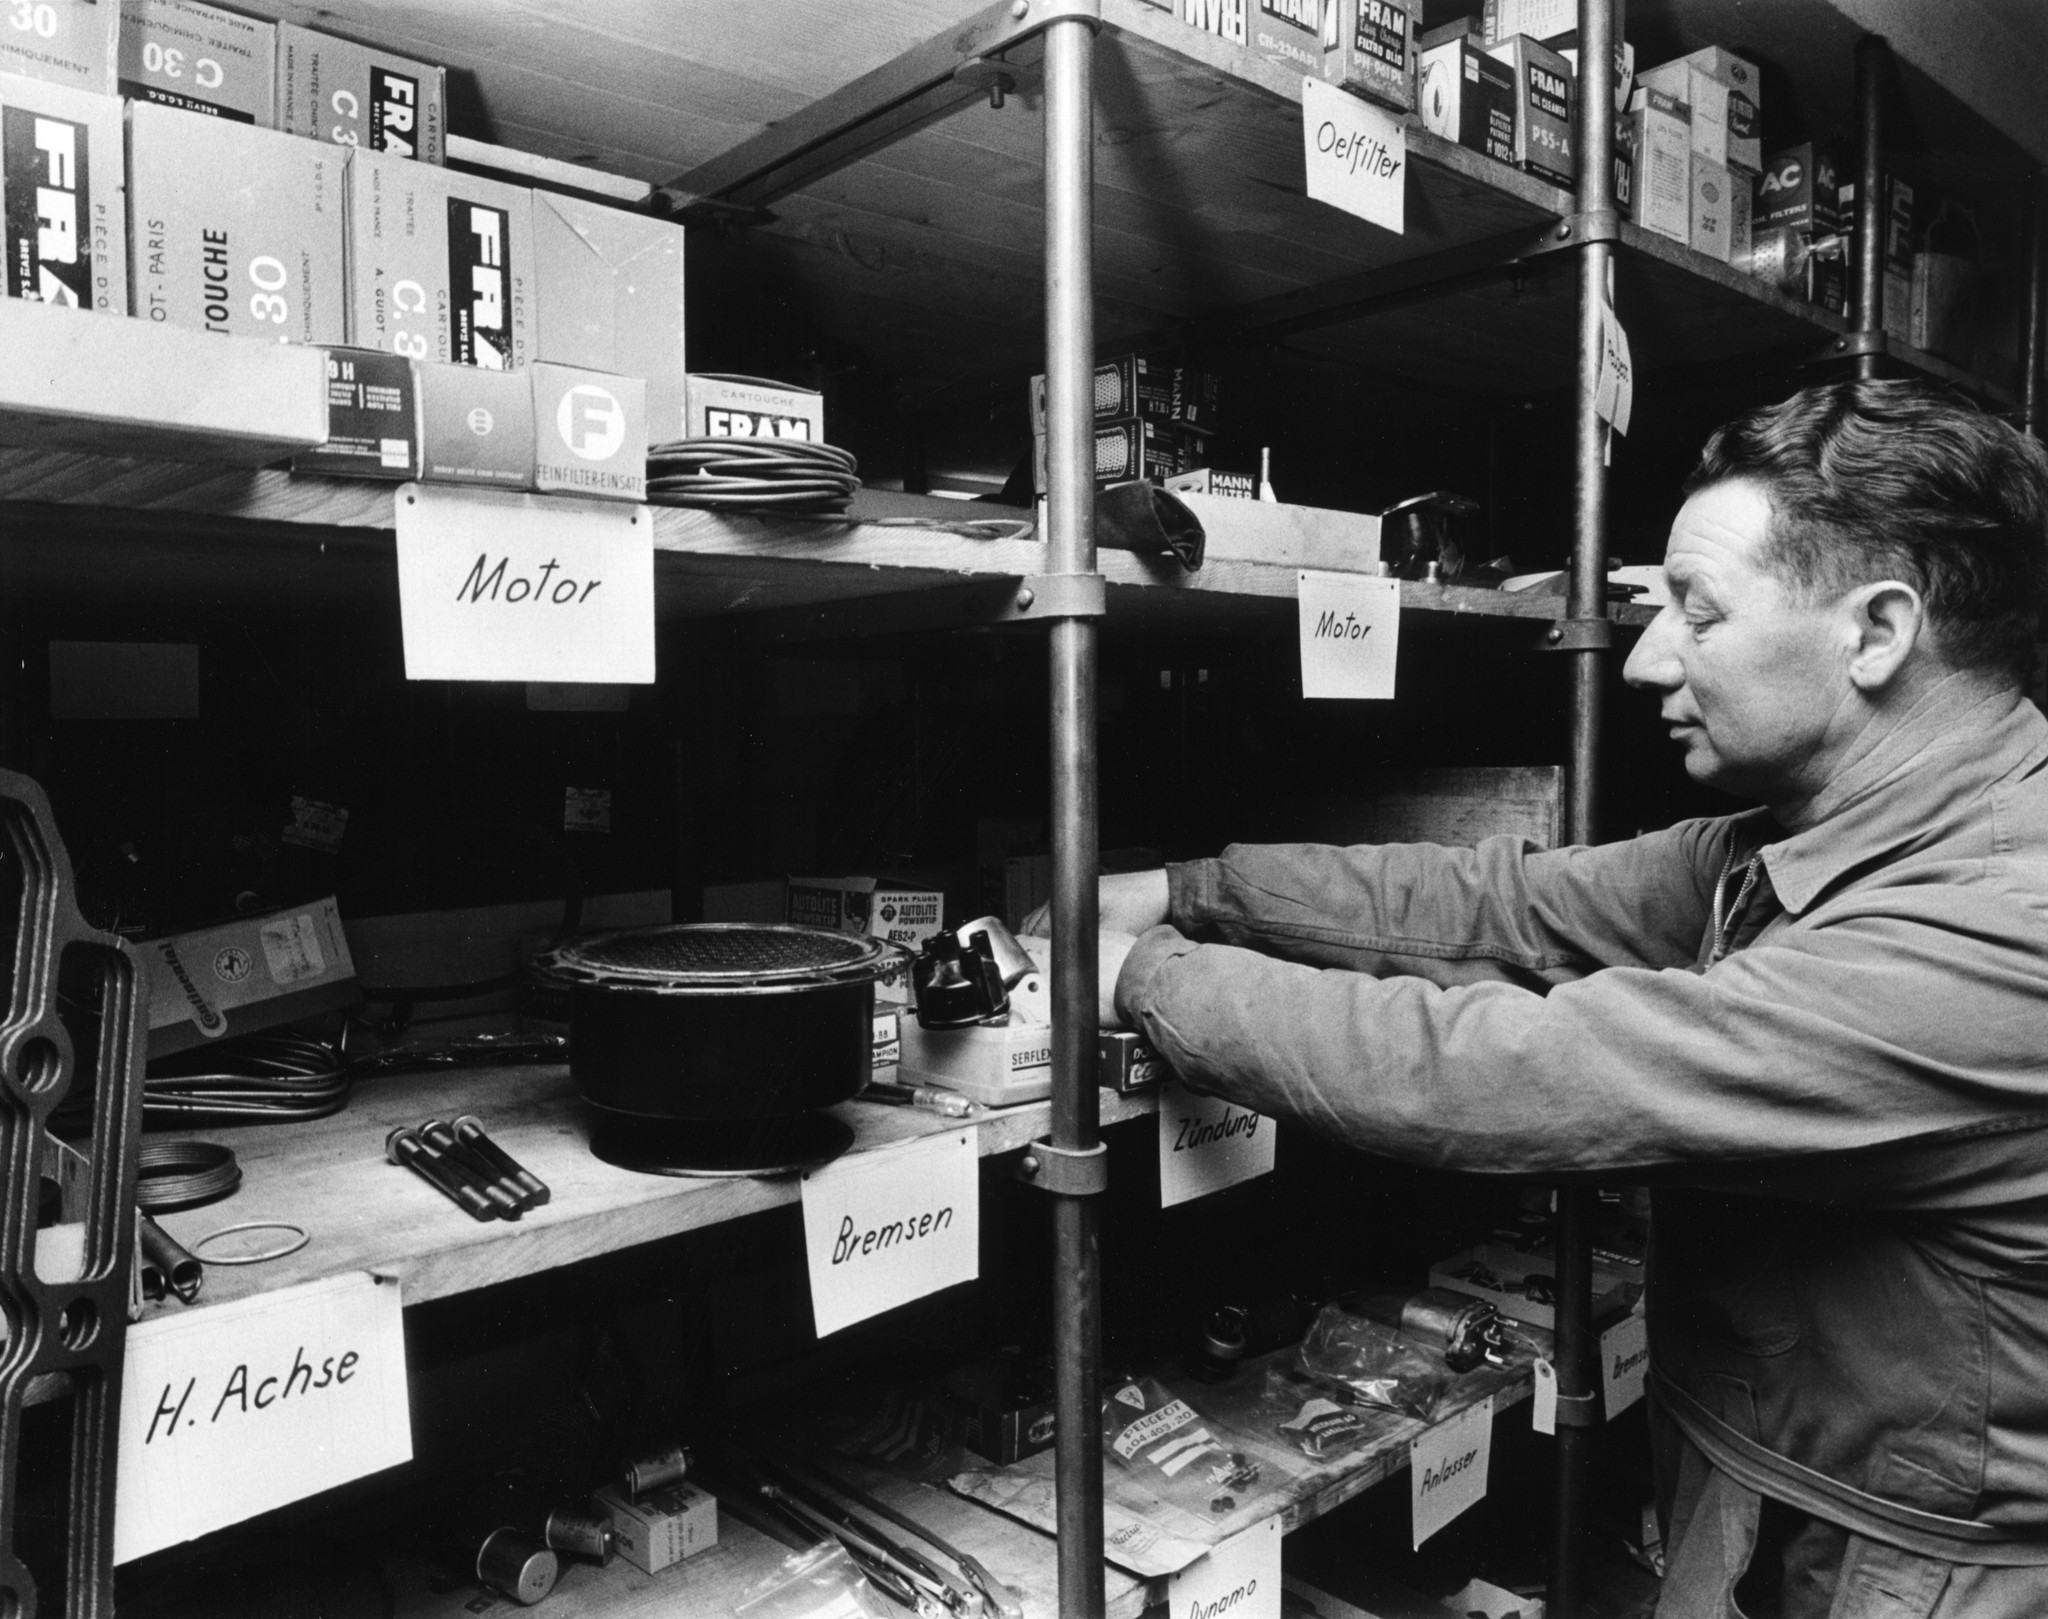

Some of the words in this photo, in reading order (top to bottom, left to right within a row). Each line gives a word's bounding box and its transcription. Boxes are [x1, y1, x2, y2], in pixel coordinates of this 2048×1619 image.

[9, 0, 57, 38] 30
[1359, 0, 1404, 36] FRAM
[1485, 16, 1496, 45] RAM
[143, 42, 184, 77] 30
[1358, 36, 1383, 57] FILTRO
[1385, 48, 1403, 66] OLIO
[196, 58, 223, 88] C
[1530, 67, 1566, 100] FRAM
[332, 90, 359, 119] C
[1317, 120, 1402, 179] Oelfilter
[1759, 164, 1801, 196] AC
[1817, 165, 1836, 190] AC
[35, 117, 79, 309] FRA
[1770, 203, 1808, 220] FILTERS
[148, 218, 165, 275] PARIS
[375, 288, 385, 333] GUIOT
[437, 289, 448, 363] CARTOU
[721, 389, 795, 407] CARTOUCHE
[1171, 368, 1183, 420] MANN
[709, 410, 808, 441] FRAM
[1212, 474, 1253, 491] MANN
[456, 553, 602, 603] Motor
[1314, 610, 1372, 640] Motor
[898, 917, 937, 926] POWERTIP
[899, 904, 938, 917] AUTOLITE
[1173, 1106, 1260, 1152] Zündung
[832, 1206, 953, 1265] Bremsen
[145, 1376, 196, 1445] H.
[211, 1346, 360, 1423] Achse
[1122, 1400, 1182, 1441] PEUGEOT
[1420, 1448, 1478, 1497] Anlasser
[1191, 1578, 1257, 1619] Dynamo
